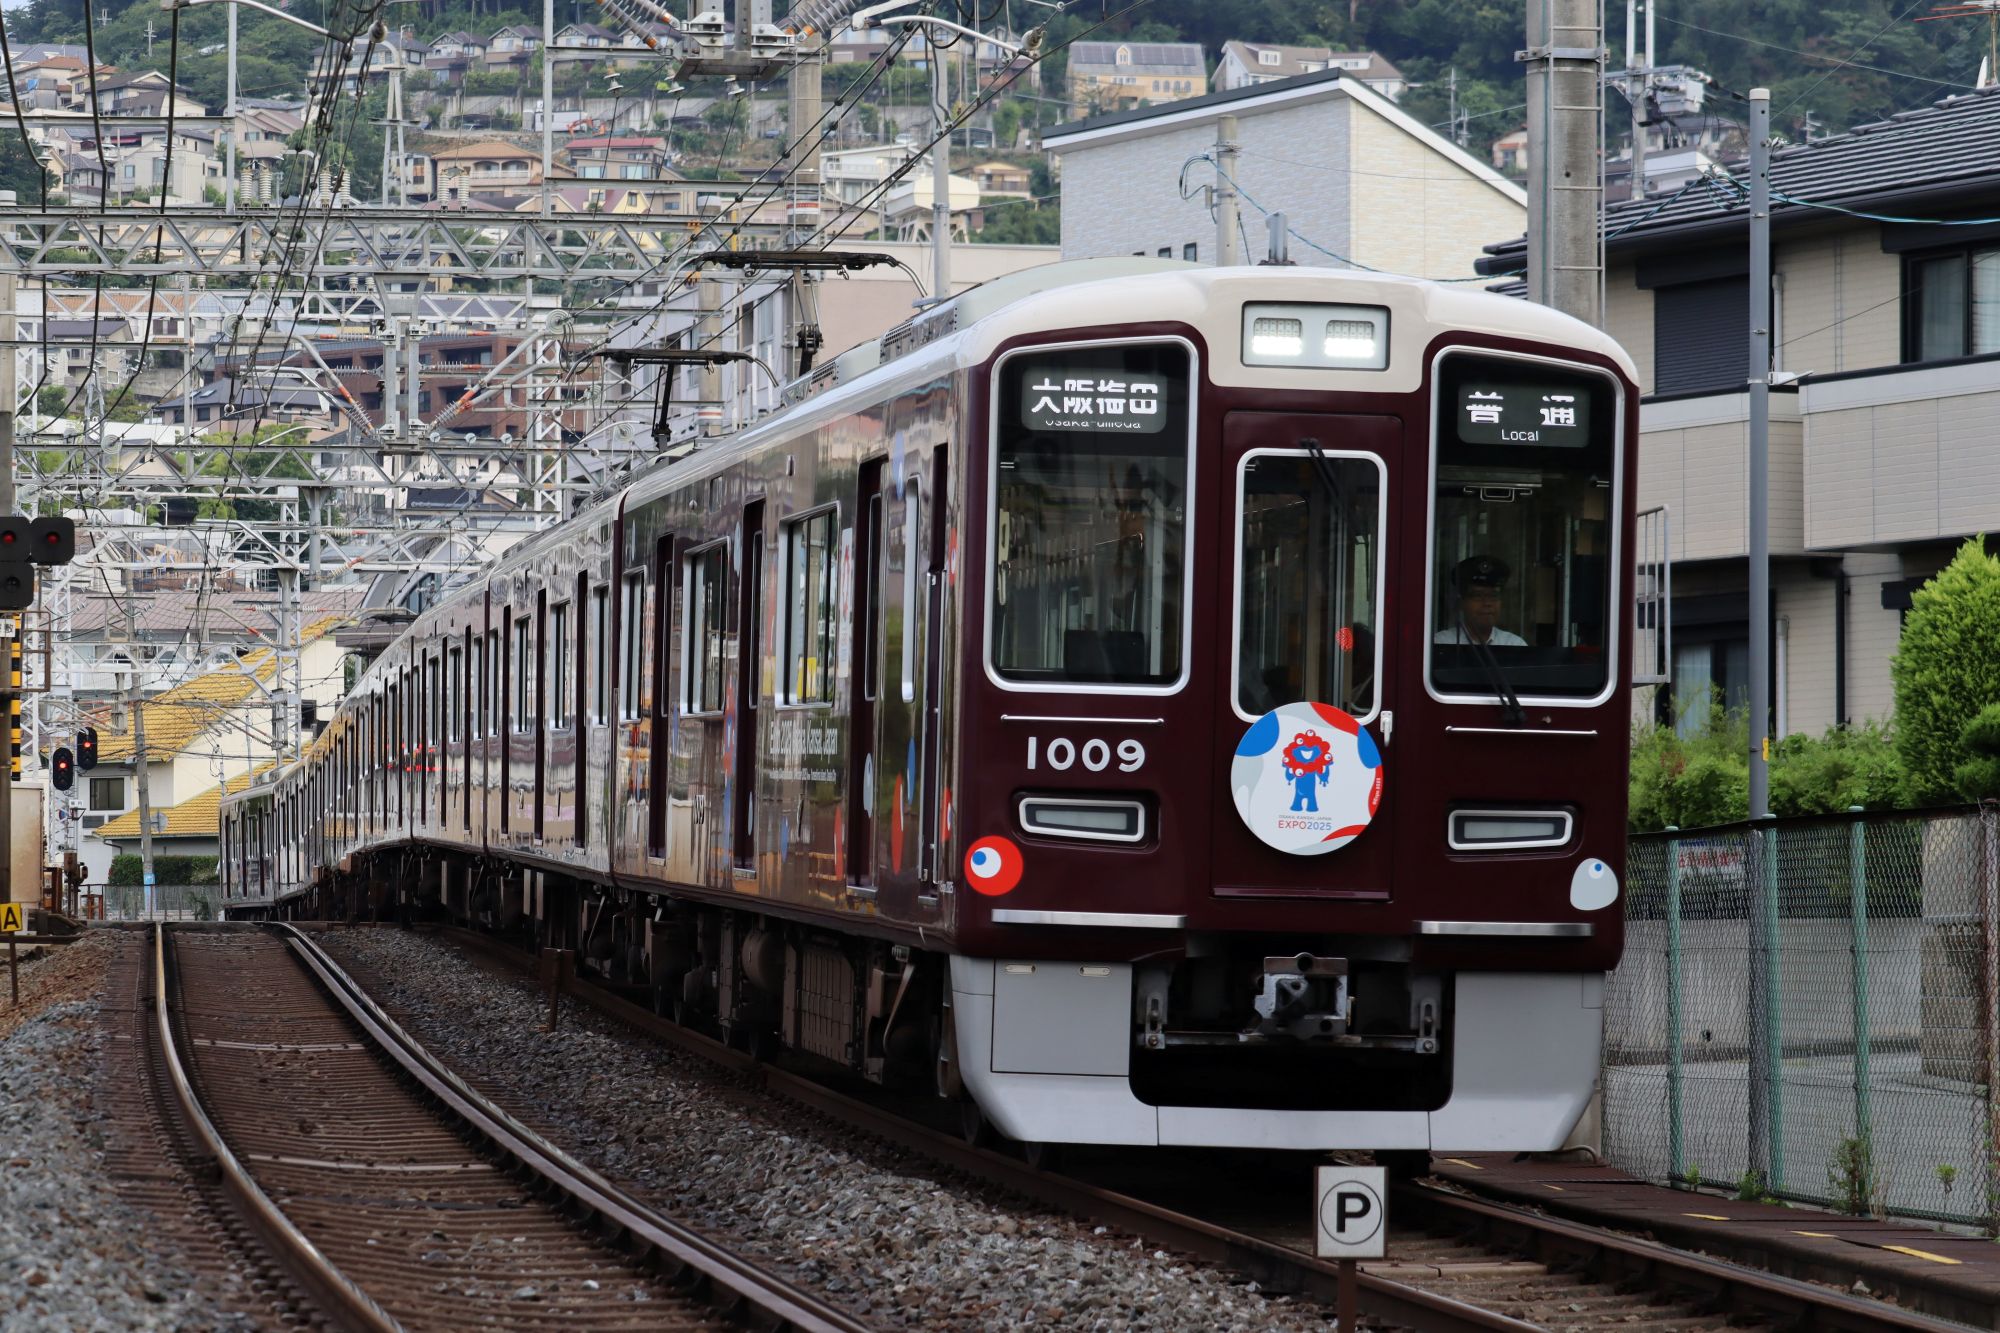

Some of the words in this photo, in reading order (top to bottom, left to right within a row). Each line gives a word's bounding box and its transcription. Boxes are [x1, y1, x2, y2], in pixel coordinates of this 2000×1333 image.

[1031, 377, 1158, 415] 大阪梅田
[1501, 429, 1539, 442] Local
[1027, 736, 1145, 773] 1009
[3, 906, 19, 930] A
[1336, 1191, 1371, 1233] P
